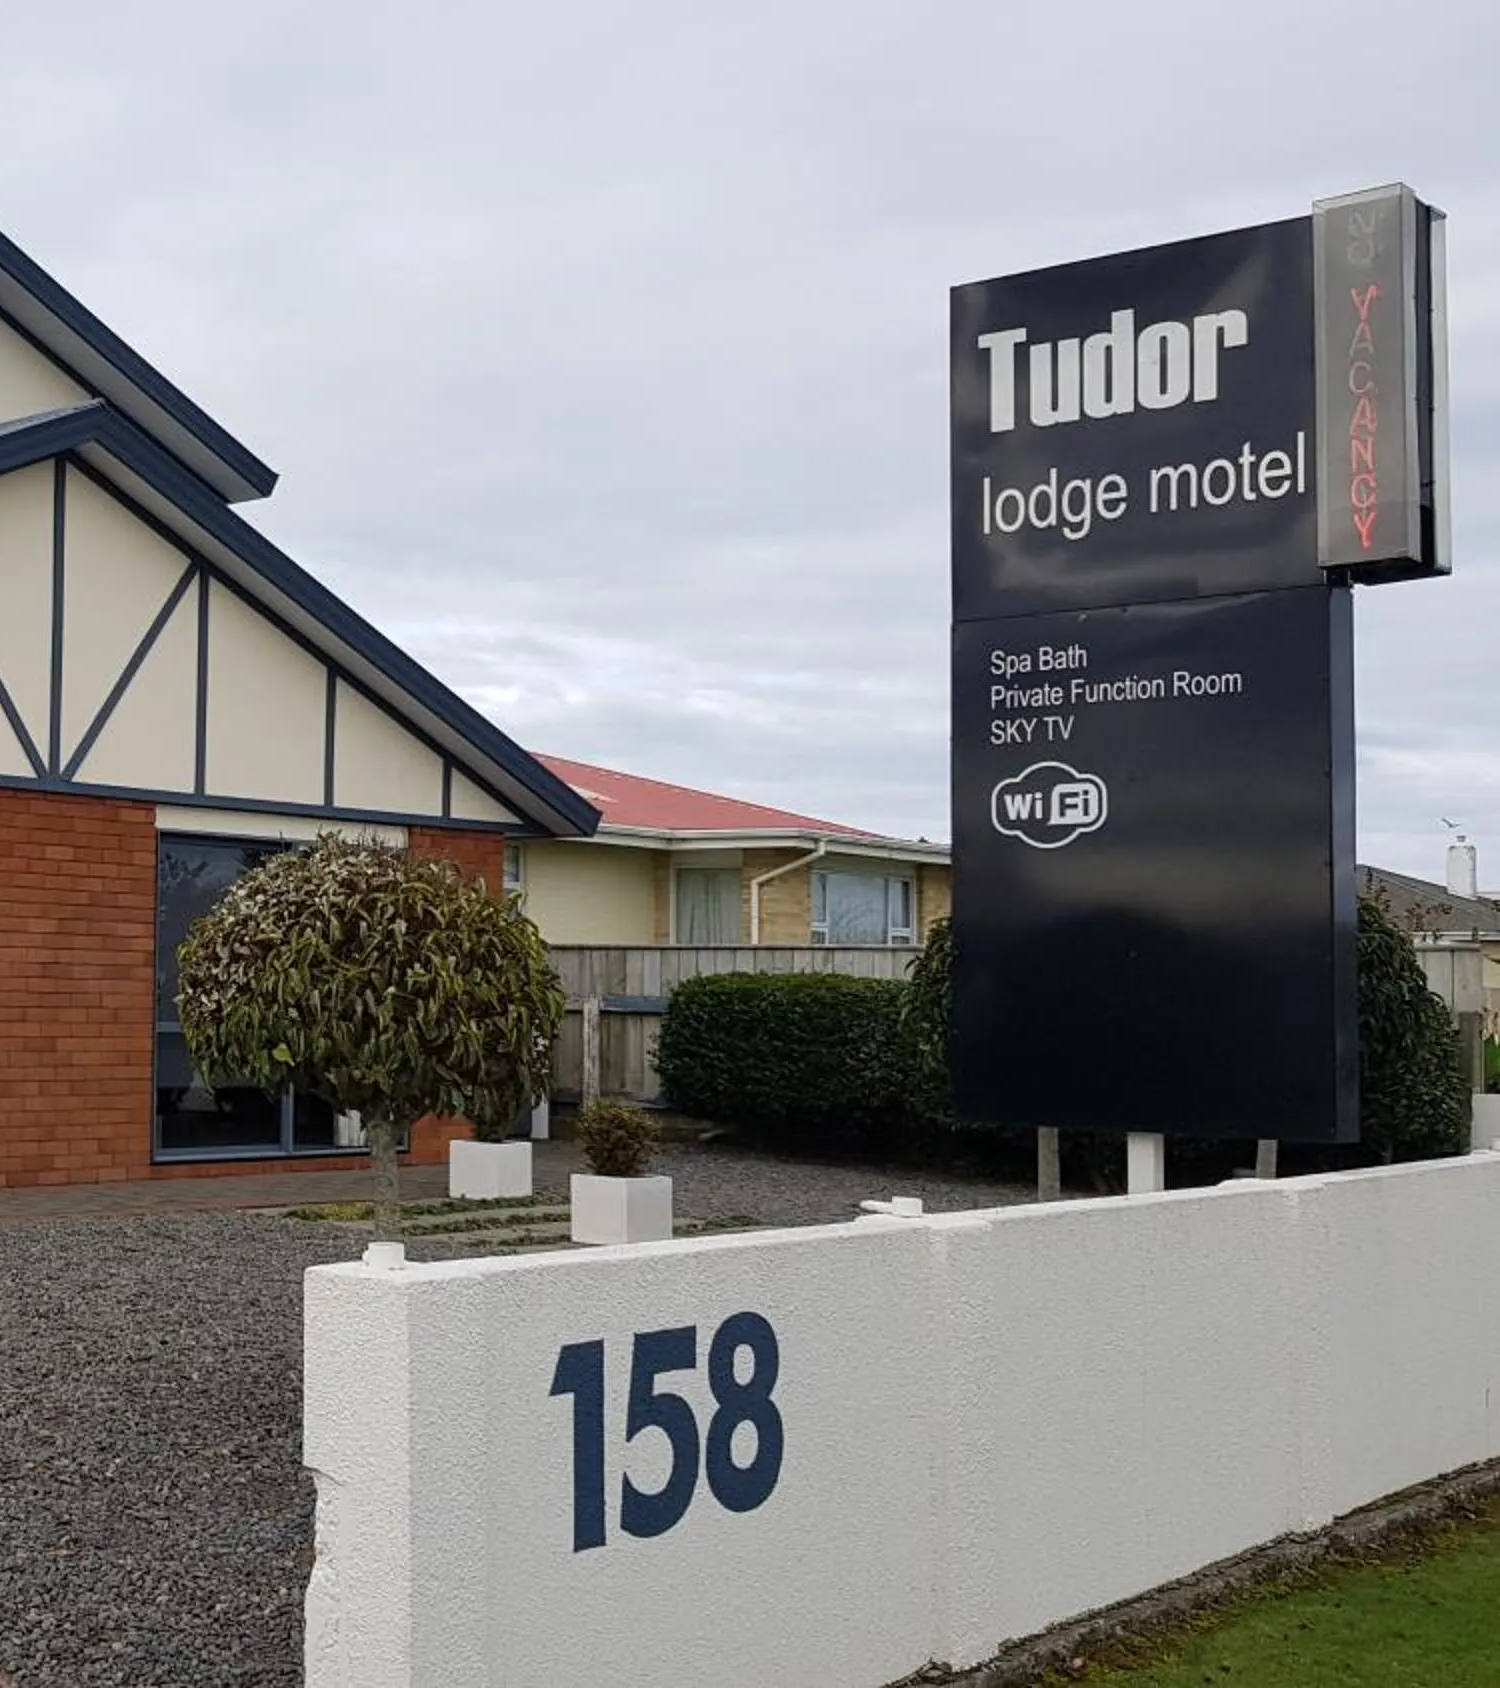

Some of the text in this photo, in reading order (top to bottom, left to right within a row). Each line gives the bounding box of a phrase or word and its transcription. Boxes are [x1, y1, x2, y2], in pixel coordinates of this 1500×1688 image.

[978, 308, 1248, 433] Tudor
[1349, 285, 1379, 549] VACANCY
[983, 431, 1305, 540] lodge motel
[990, 644, 1088, 680] Spa Bath
[990, 670, 1243, 710] Private Function Room
[990, 715, 1075, 745] SKY TV
[548, 1311, 784, 1553] 158
